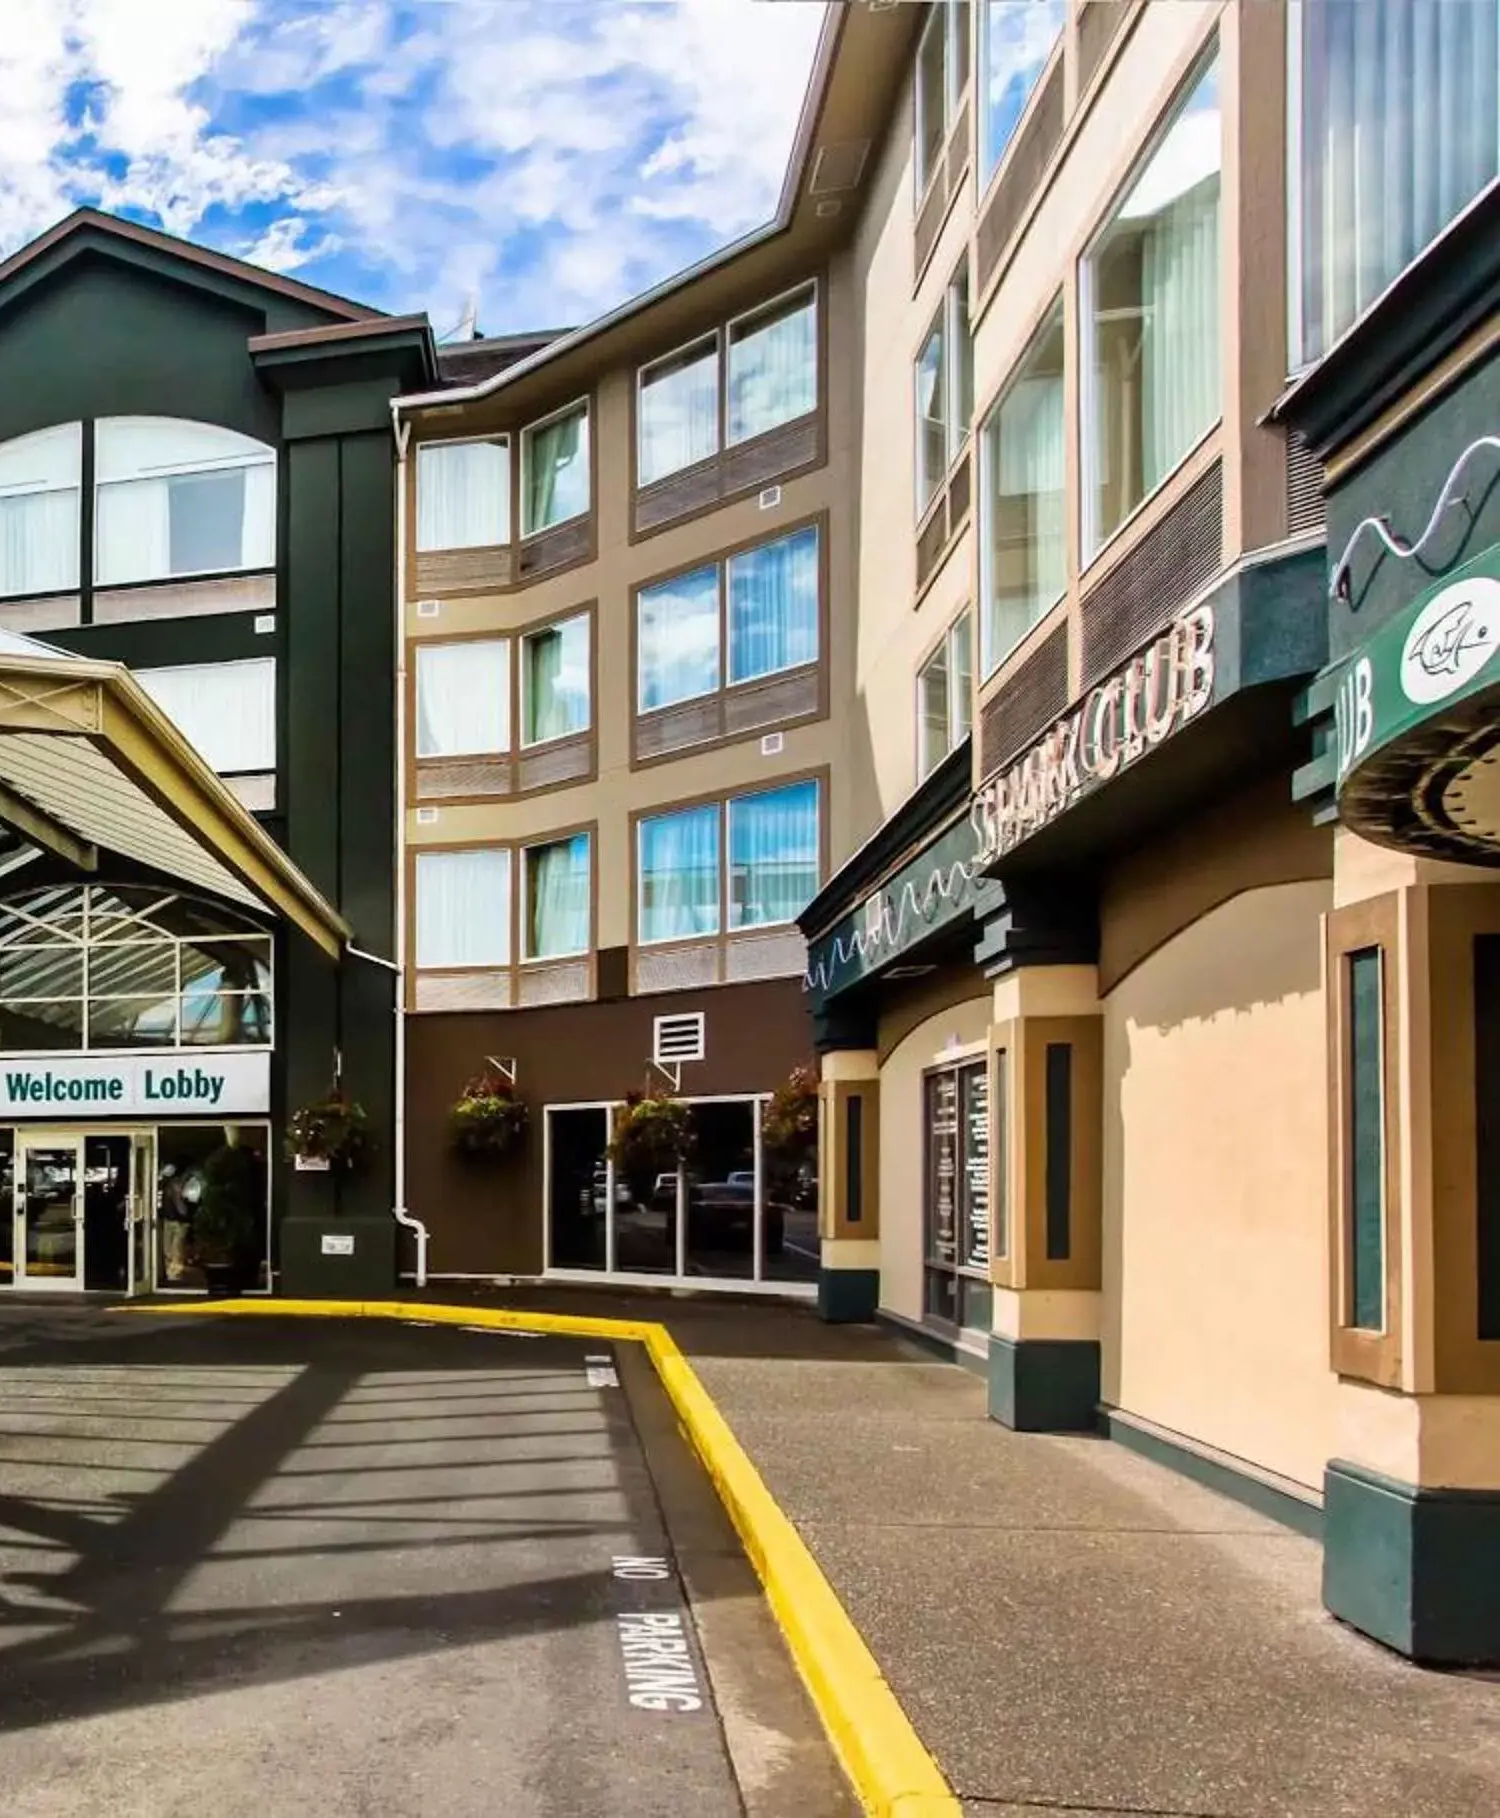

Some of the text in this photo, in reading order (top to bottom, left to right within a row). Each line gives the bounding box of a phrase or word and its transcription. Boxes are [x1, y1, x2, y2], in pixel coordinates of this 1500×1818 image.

[1079, 605, 1214, 780] CLUB
[5, 1069, 225, 1103] Welcome Lobby
[611, 1556, 702, 1711] NO PARKING
